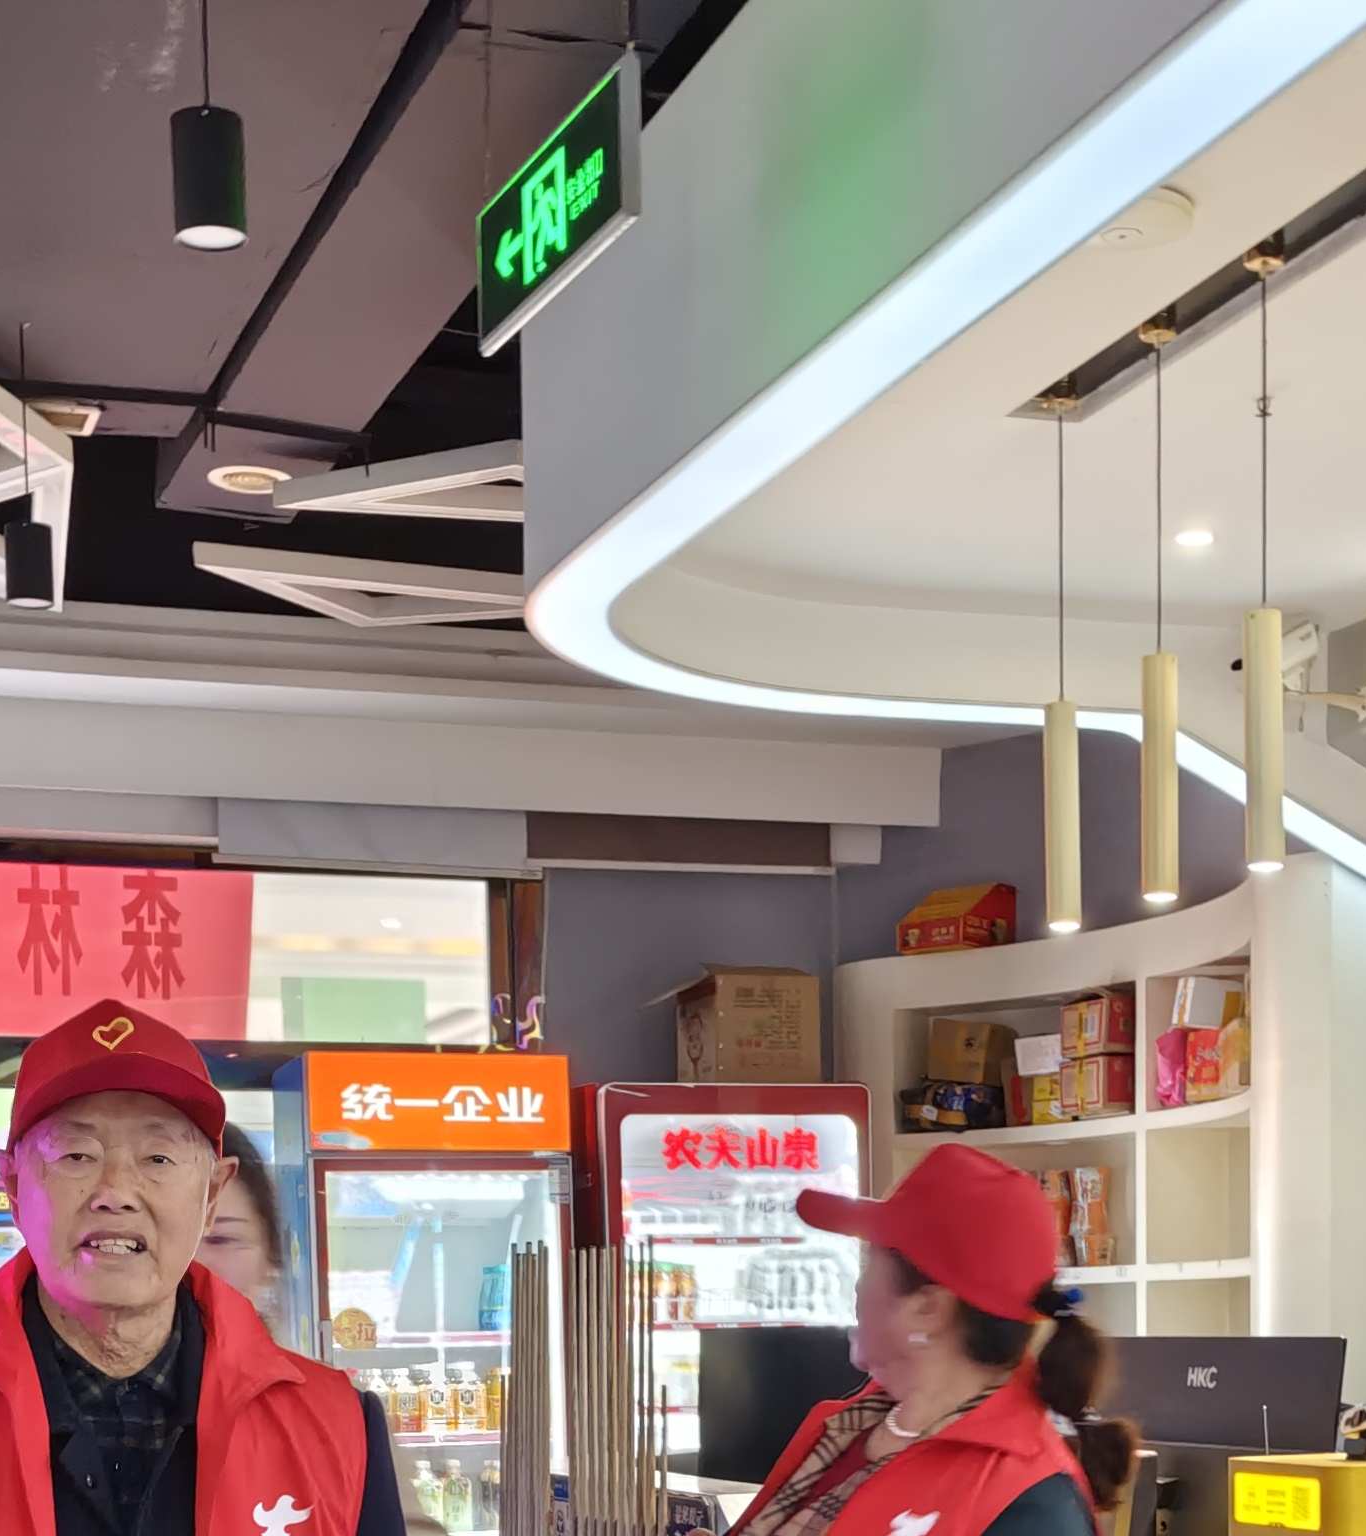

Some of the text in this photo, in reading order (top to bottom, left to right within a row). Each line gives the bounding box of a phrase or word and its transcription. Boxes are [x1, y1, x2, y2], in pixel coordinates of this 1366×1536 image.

[570, 180, 600, 220] EXIT
[341, 1083, 546, 1123] 统一企业
[662, 1126, 820, 1171] 农夫山泉
[1187, 1366, 1218, 1389] HKC
